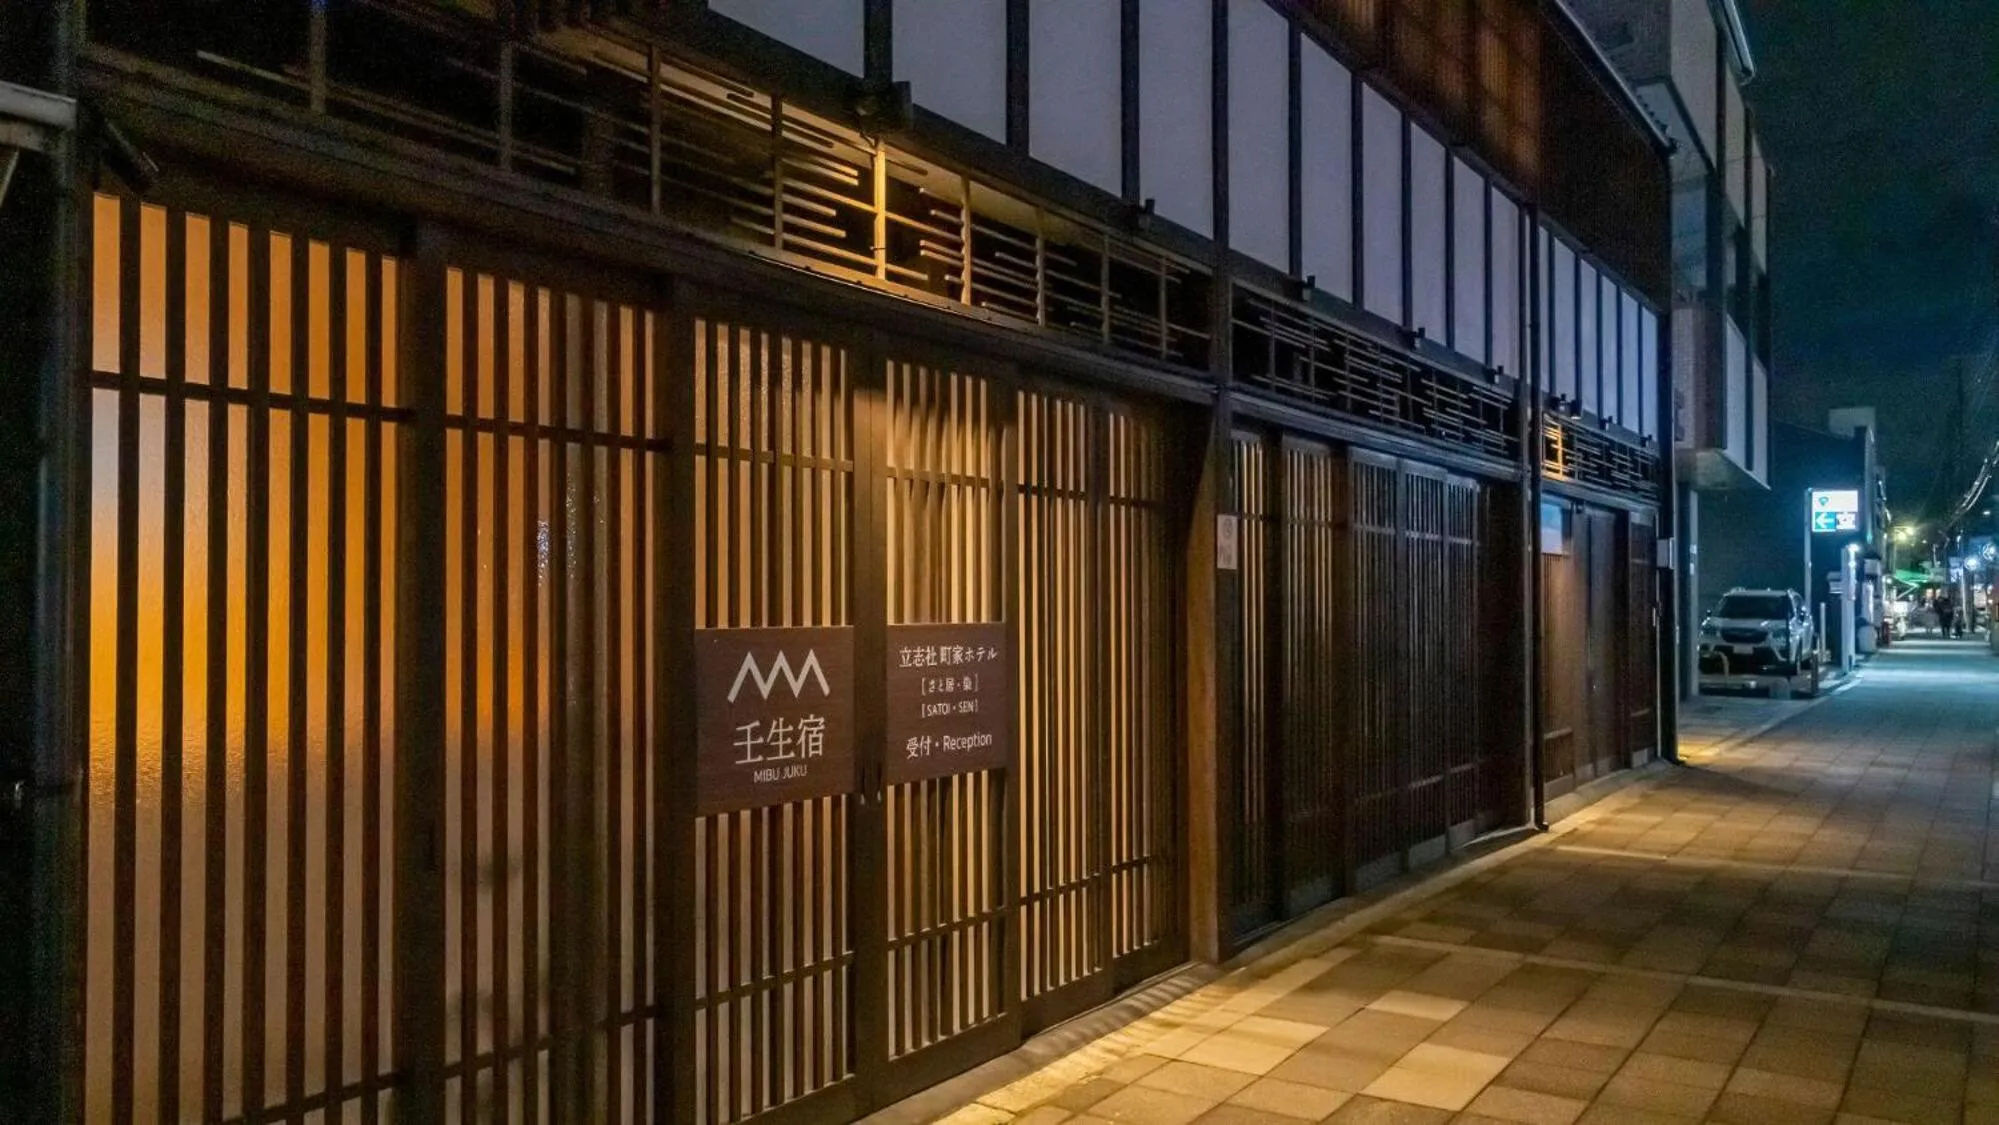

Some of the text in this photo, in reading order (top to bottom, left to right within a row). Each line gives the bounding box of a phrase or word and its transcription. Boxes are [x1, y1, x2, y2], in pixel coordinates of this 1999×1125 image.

[733, 713, 825, 764] 壬生宿
[753, 764, 808, 783] MIBU JUKU
